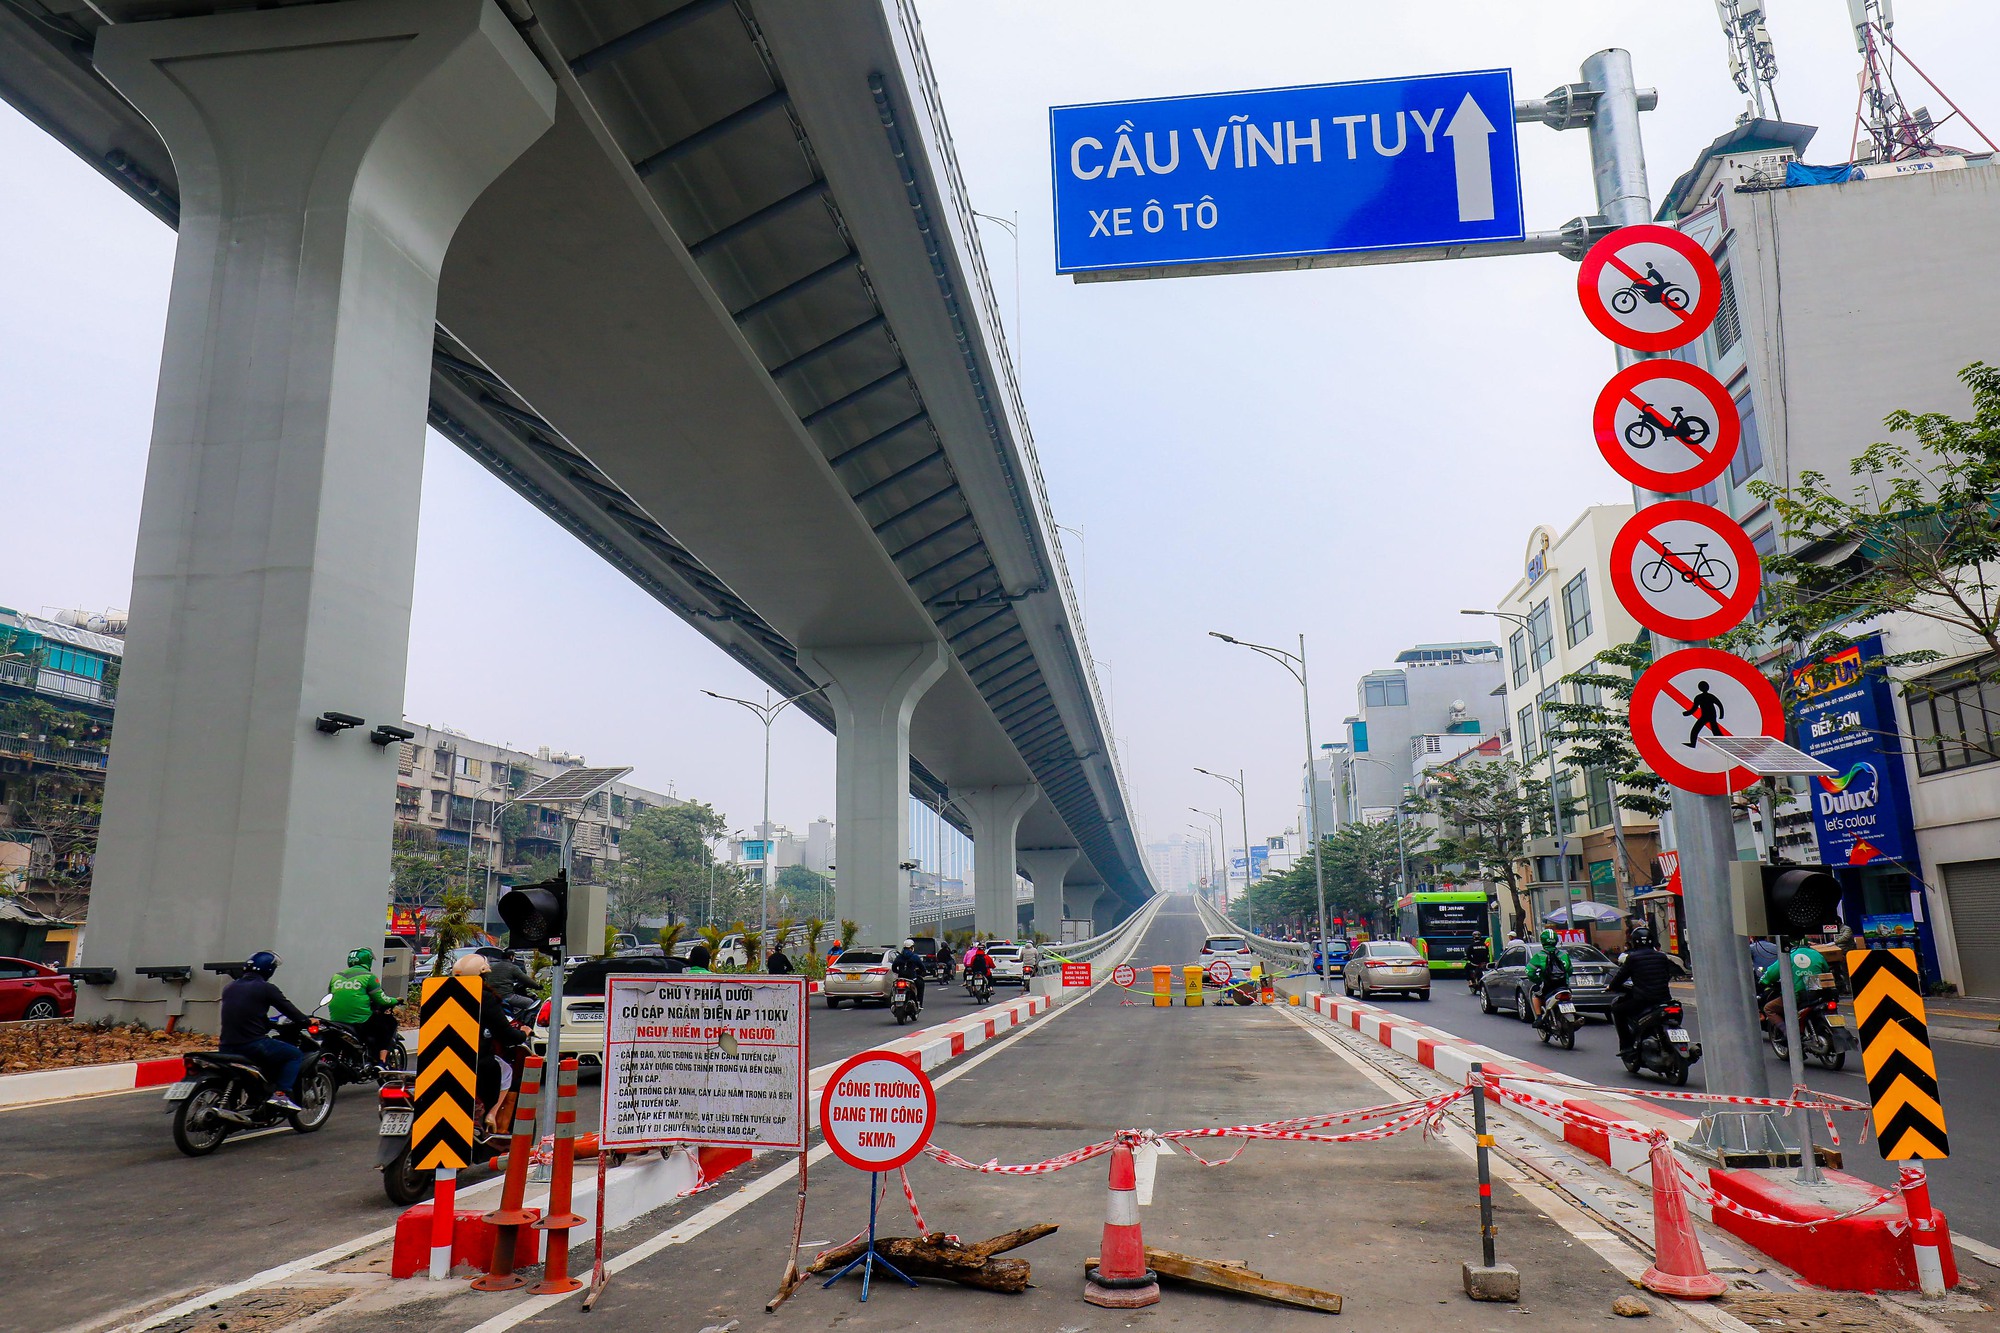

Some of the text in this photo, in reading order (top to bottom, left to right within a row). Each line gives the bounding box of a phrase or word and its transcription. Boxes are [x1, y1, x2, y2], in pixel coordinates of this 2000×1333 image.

[1070, 107, 1444, 181] CẦU VĨNH TUY
[1088, 194, 1218, 238] XE Ô TÔ
[1819, 789, 1874, 815] Dulux
[1825, 817, 1844, 831] let's
[1845, 814, 1877, 828] colour
[334, 979, 362, 990] Grab
[659, 986, 753, 1001] CHÚ Ý PHÍA DƯỚI
[622, 1004, 788, 1021] CÓ CÁP NGẦM ĐIỆN ÁP 110KV
[637, 1026, 668, 1038] NGUY
[672, 1023, 700, 1038] HIỂM
[740, 1026, 775, 1040] NGƯỜI
[838, 1079, 920, 1098] CÔNG TRƯỜNG
[833, 1105, 923, 1123] ĐANG THI CÔNG
[858, 1131, 896, 1148] 5KM/h
